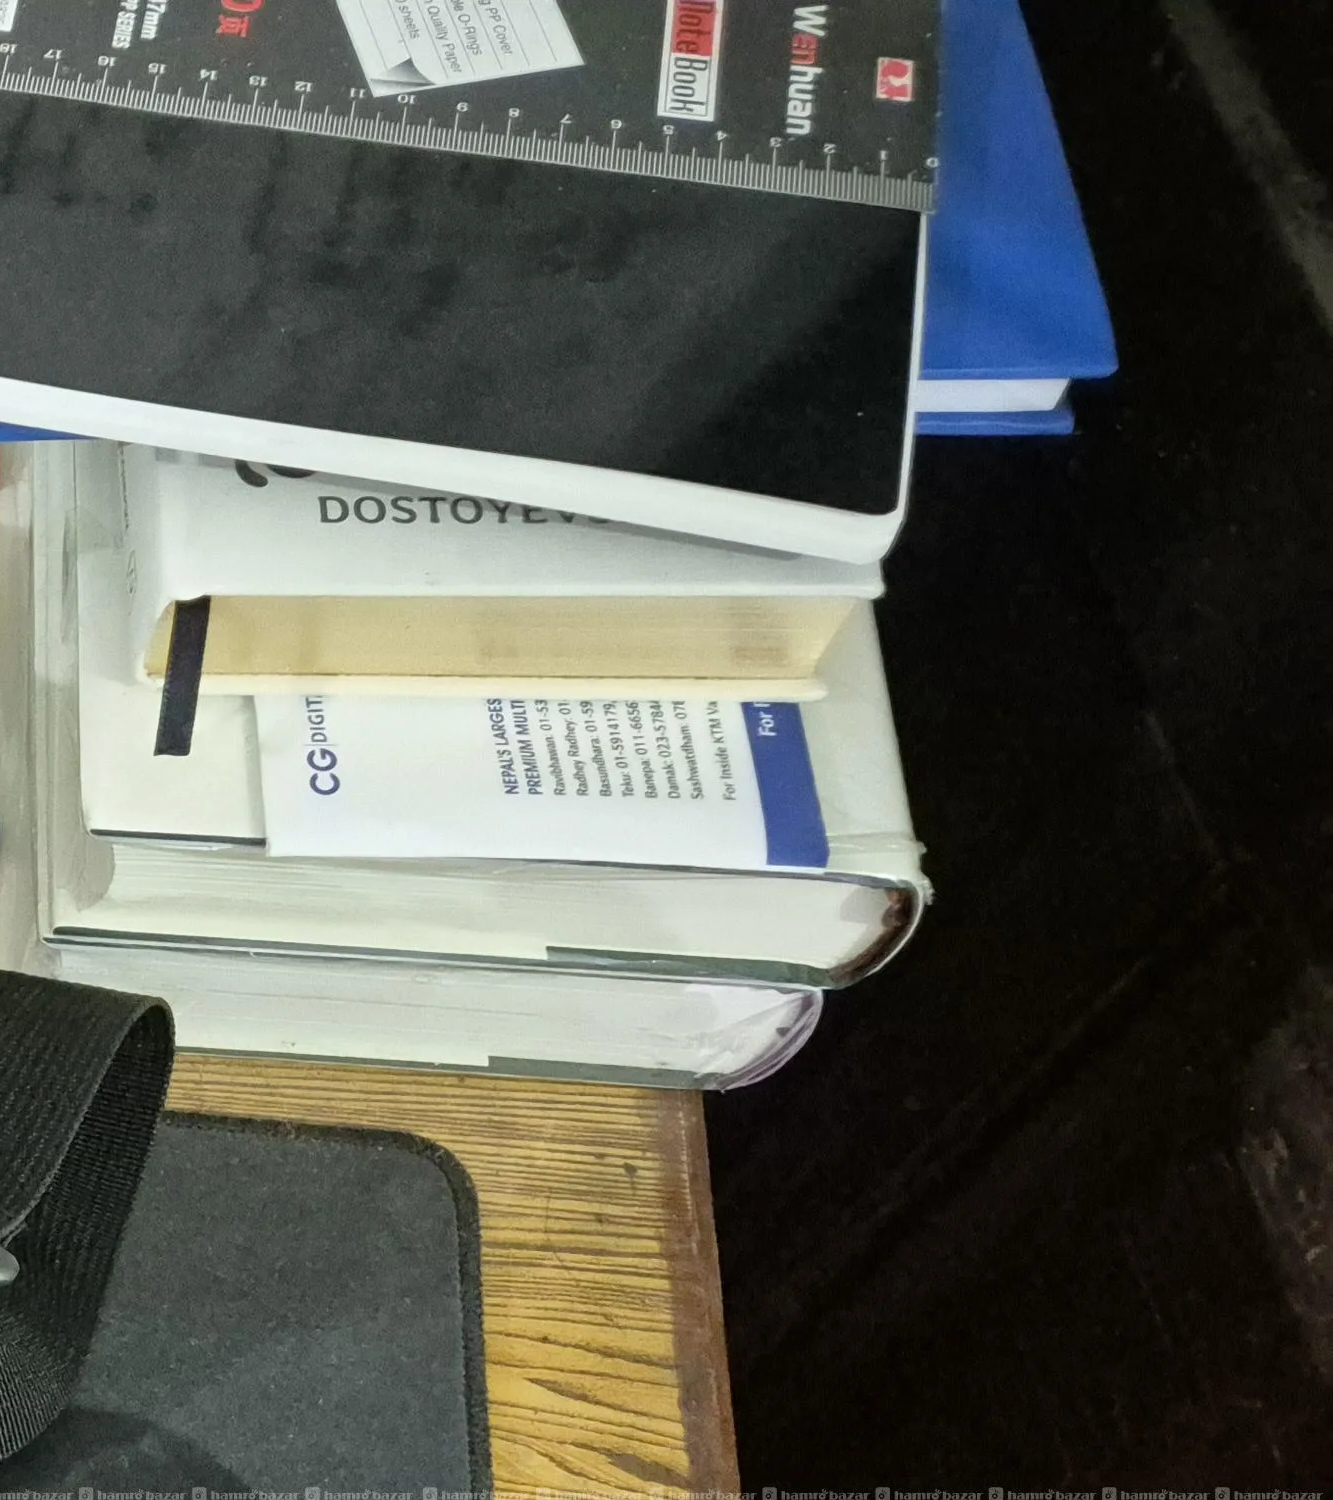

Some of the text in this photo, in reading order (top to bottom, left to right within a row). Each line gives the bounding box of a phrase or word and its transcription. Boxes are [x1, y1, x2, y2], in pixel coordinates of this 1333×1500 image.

[398, 5, 421, 40] sheets
[492, 23, 514, 56] Cover
[43, 48, 63, 60] 17
[441, 41, 462, 74] Paper
[200, 69, 218, 81] 14
[295, 80, 313, 92] 12
[349, 87, 366, 99] 11
[397, 94, 417, 105] 10
[757, 711, 778, 736] For
[305, 697, 340, 795] CG DIGIT
[517, 740, 543, 795] PREMIUM
